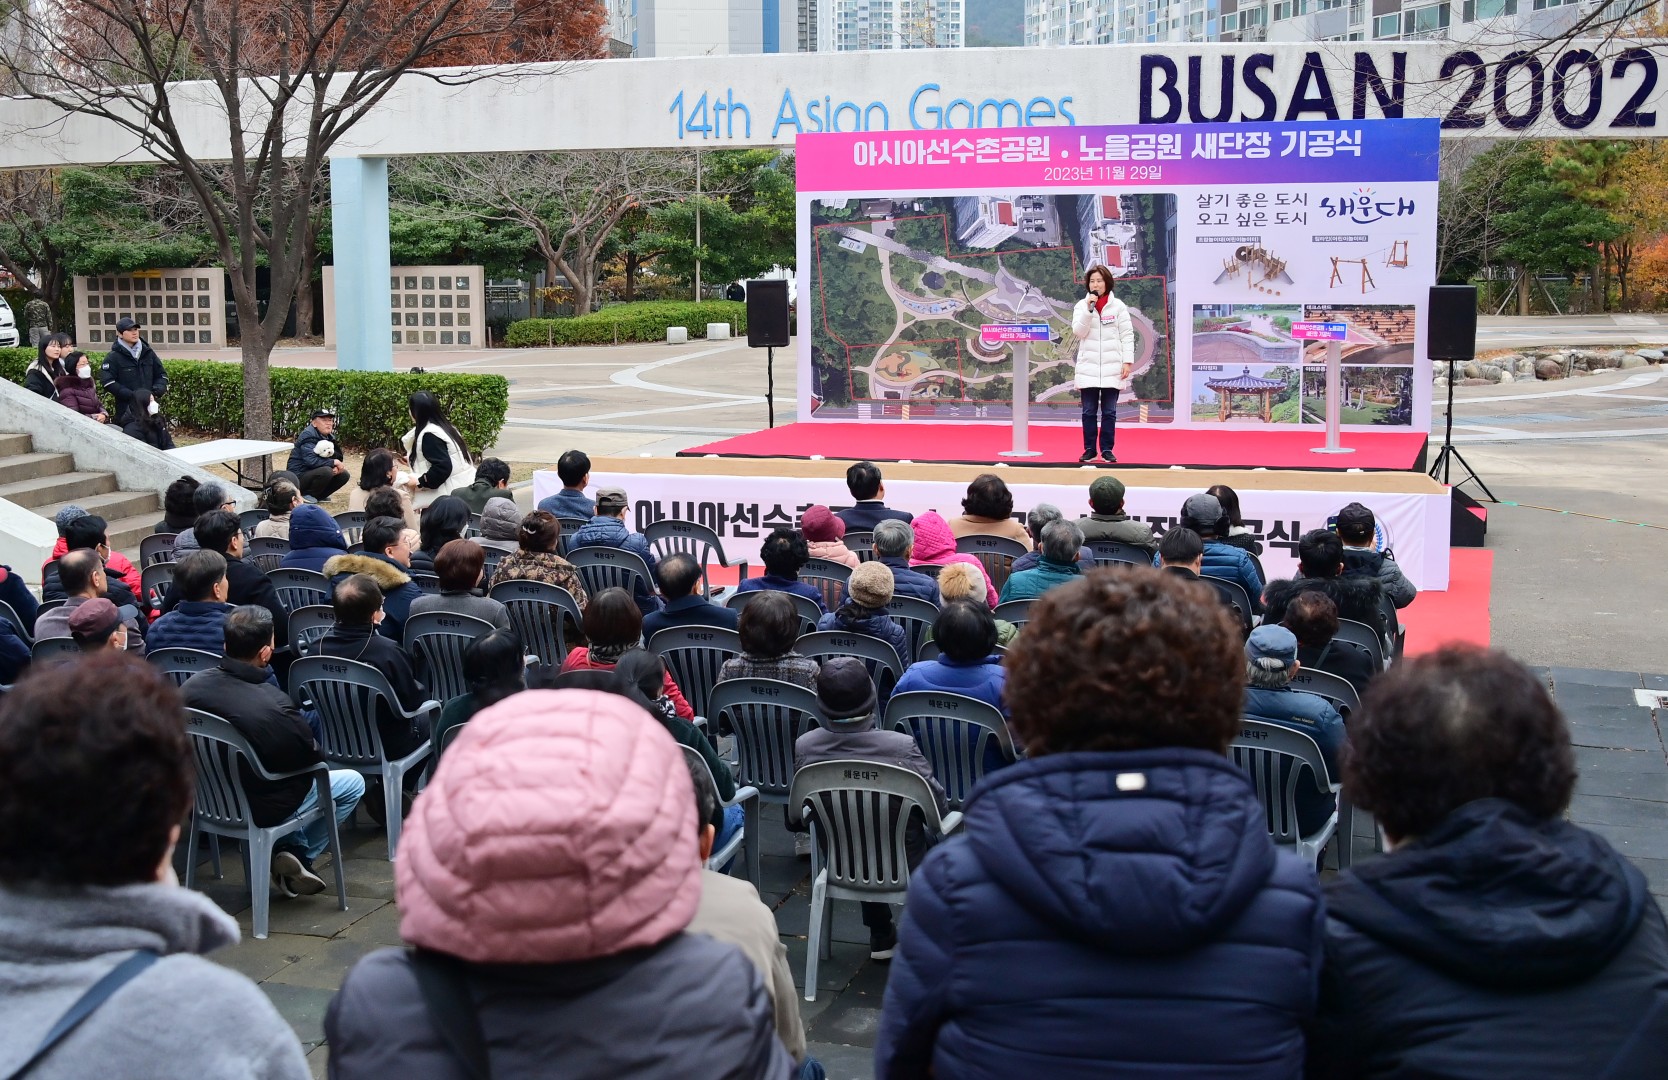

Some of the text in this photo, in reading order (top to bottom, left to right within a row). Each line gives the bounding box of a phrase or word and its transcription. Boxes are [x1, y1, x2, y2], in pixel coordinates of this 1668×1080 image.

[1138, 48, 1659, 130] BUSAN 2002
[670, 82, 1076, 139] 14th Asian Games
[853, 129, 1362, 166] 아시아선수촌공원 노을공원 새단장 기공식
[1044, 165, 1162, 181] 2023년 11월 29일
[1196, 192, 1308, 209] 살기 좋은 도시
[1318, 196, 1415, 224] 해운대
[1196, 211, 1308, 227] 오고 싶은 도시
[687, 632, 714, 641] 해운대구
[830, 638, 857, 647] 해운대구
[322, 663, 348, 674] 해운대구
[750, 685, 780, 696] 해운대구
[929, 699, 959, 710] 해운대구
[843, 769, 879, 781] 해운대구
